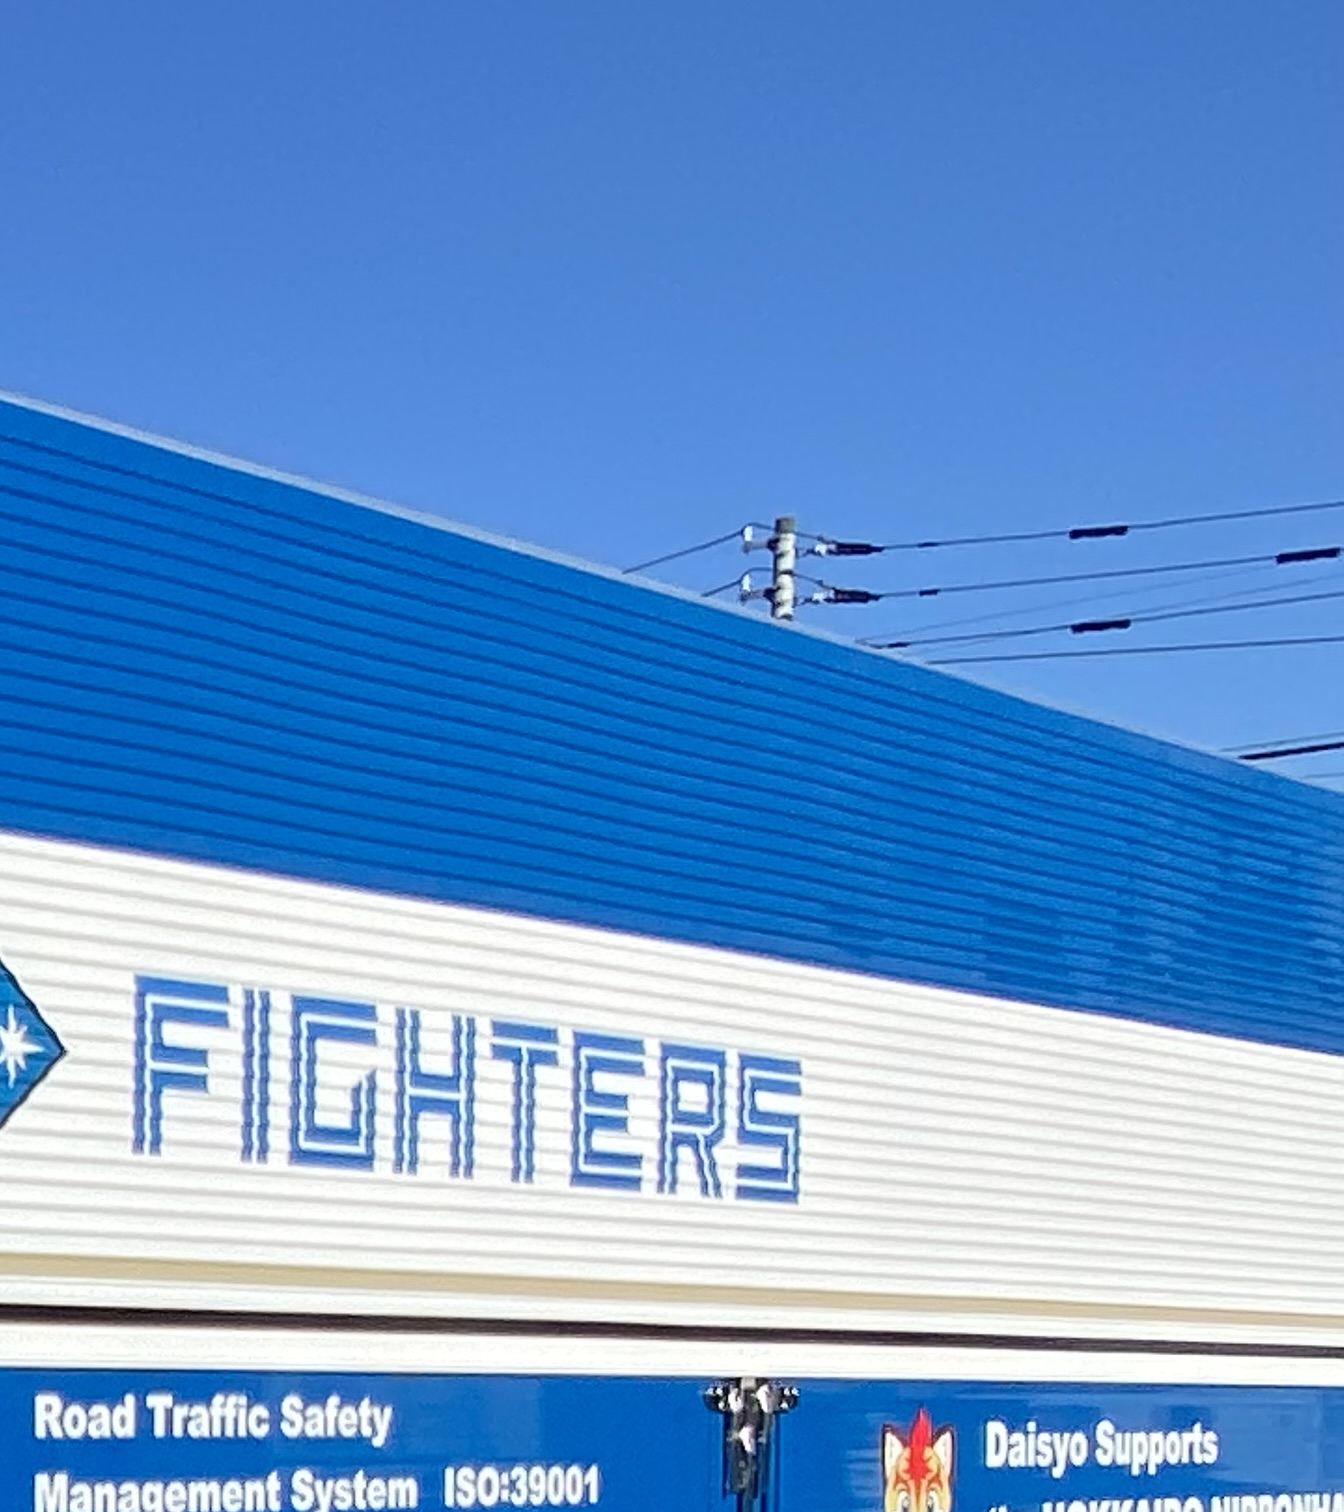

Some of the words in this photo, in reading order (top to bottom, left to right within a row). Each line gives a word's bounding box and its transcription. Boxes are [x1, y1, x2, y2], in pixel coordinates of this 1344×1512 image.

[131, 972, 804, 1204] FIGHTERS
[33, 1391, 137, 1440] Road
[145, 1391, 271, 1440] Traffic
[279, 1392, 394, 1449] Safety
[985, 1419, 1090, 1479] Daisyo
[1095, 1419, 1220, 1476] Supports
[443, 1463, 601, 1509] ISO:39001
